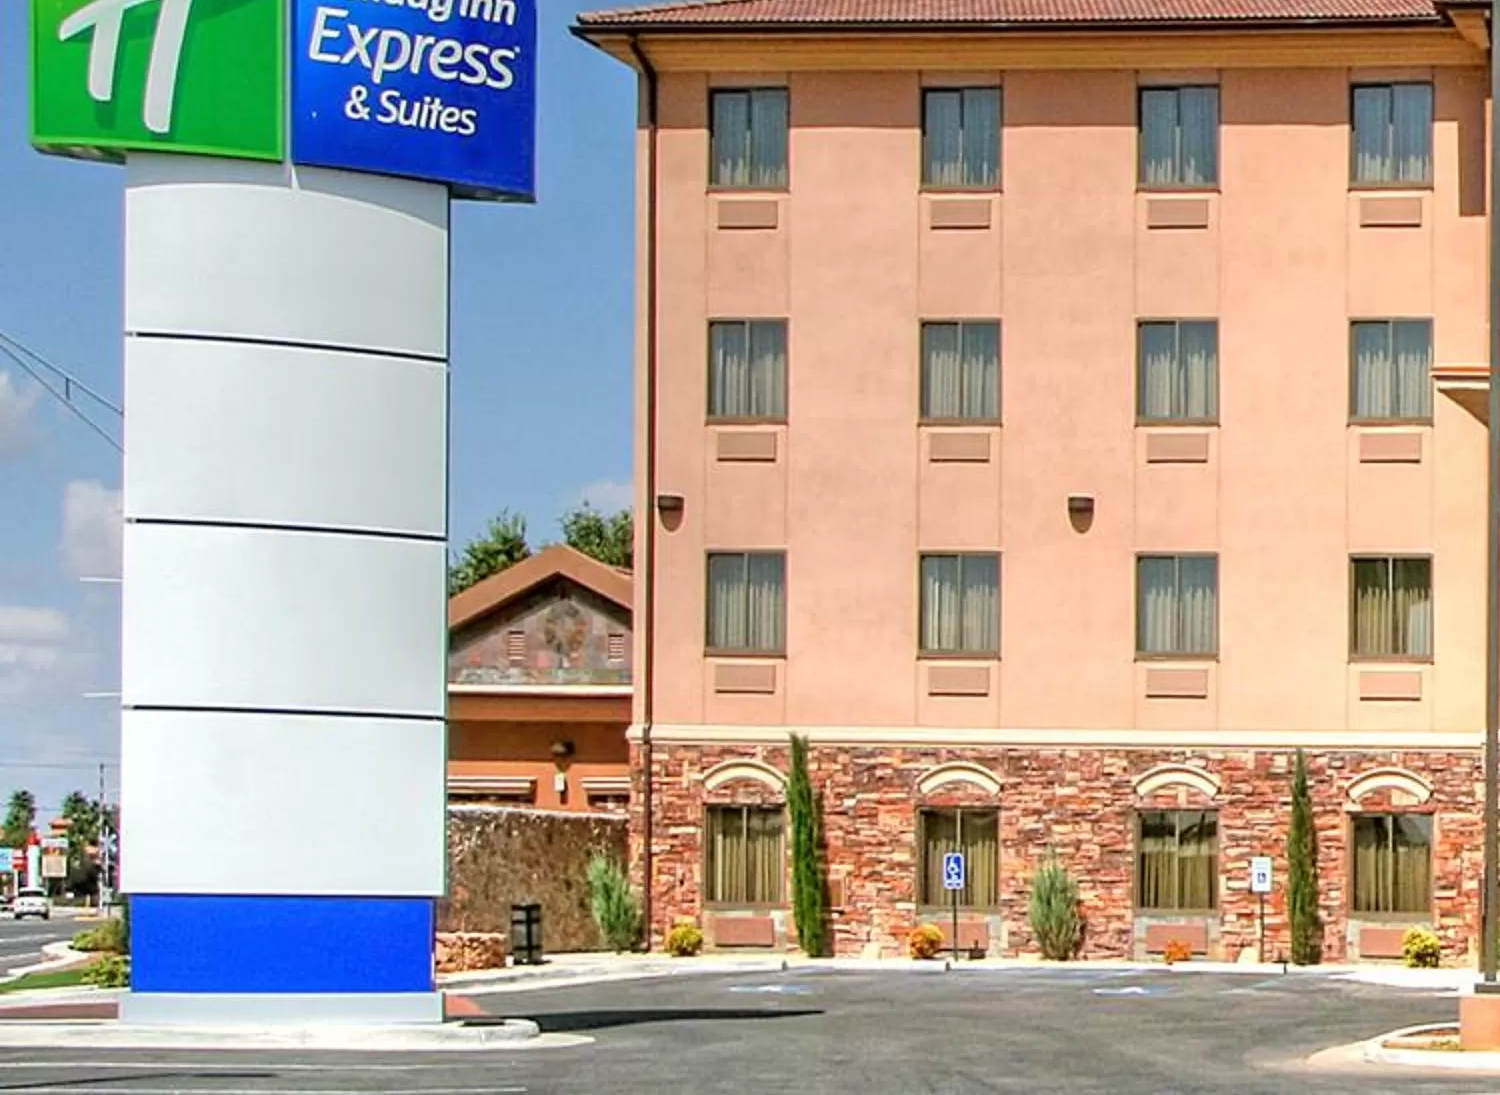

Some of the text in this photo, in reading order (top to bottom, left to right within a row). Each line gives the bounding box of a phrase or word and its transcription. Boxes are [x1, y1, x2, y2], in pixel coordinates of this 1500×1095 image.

[309, 6, 515, 90] Express
[344, 85, 477, 136] & Suites
